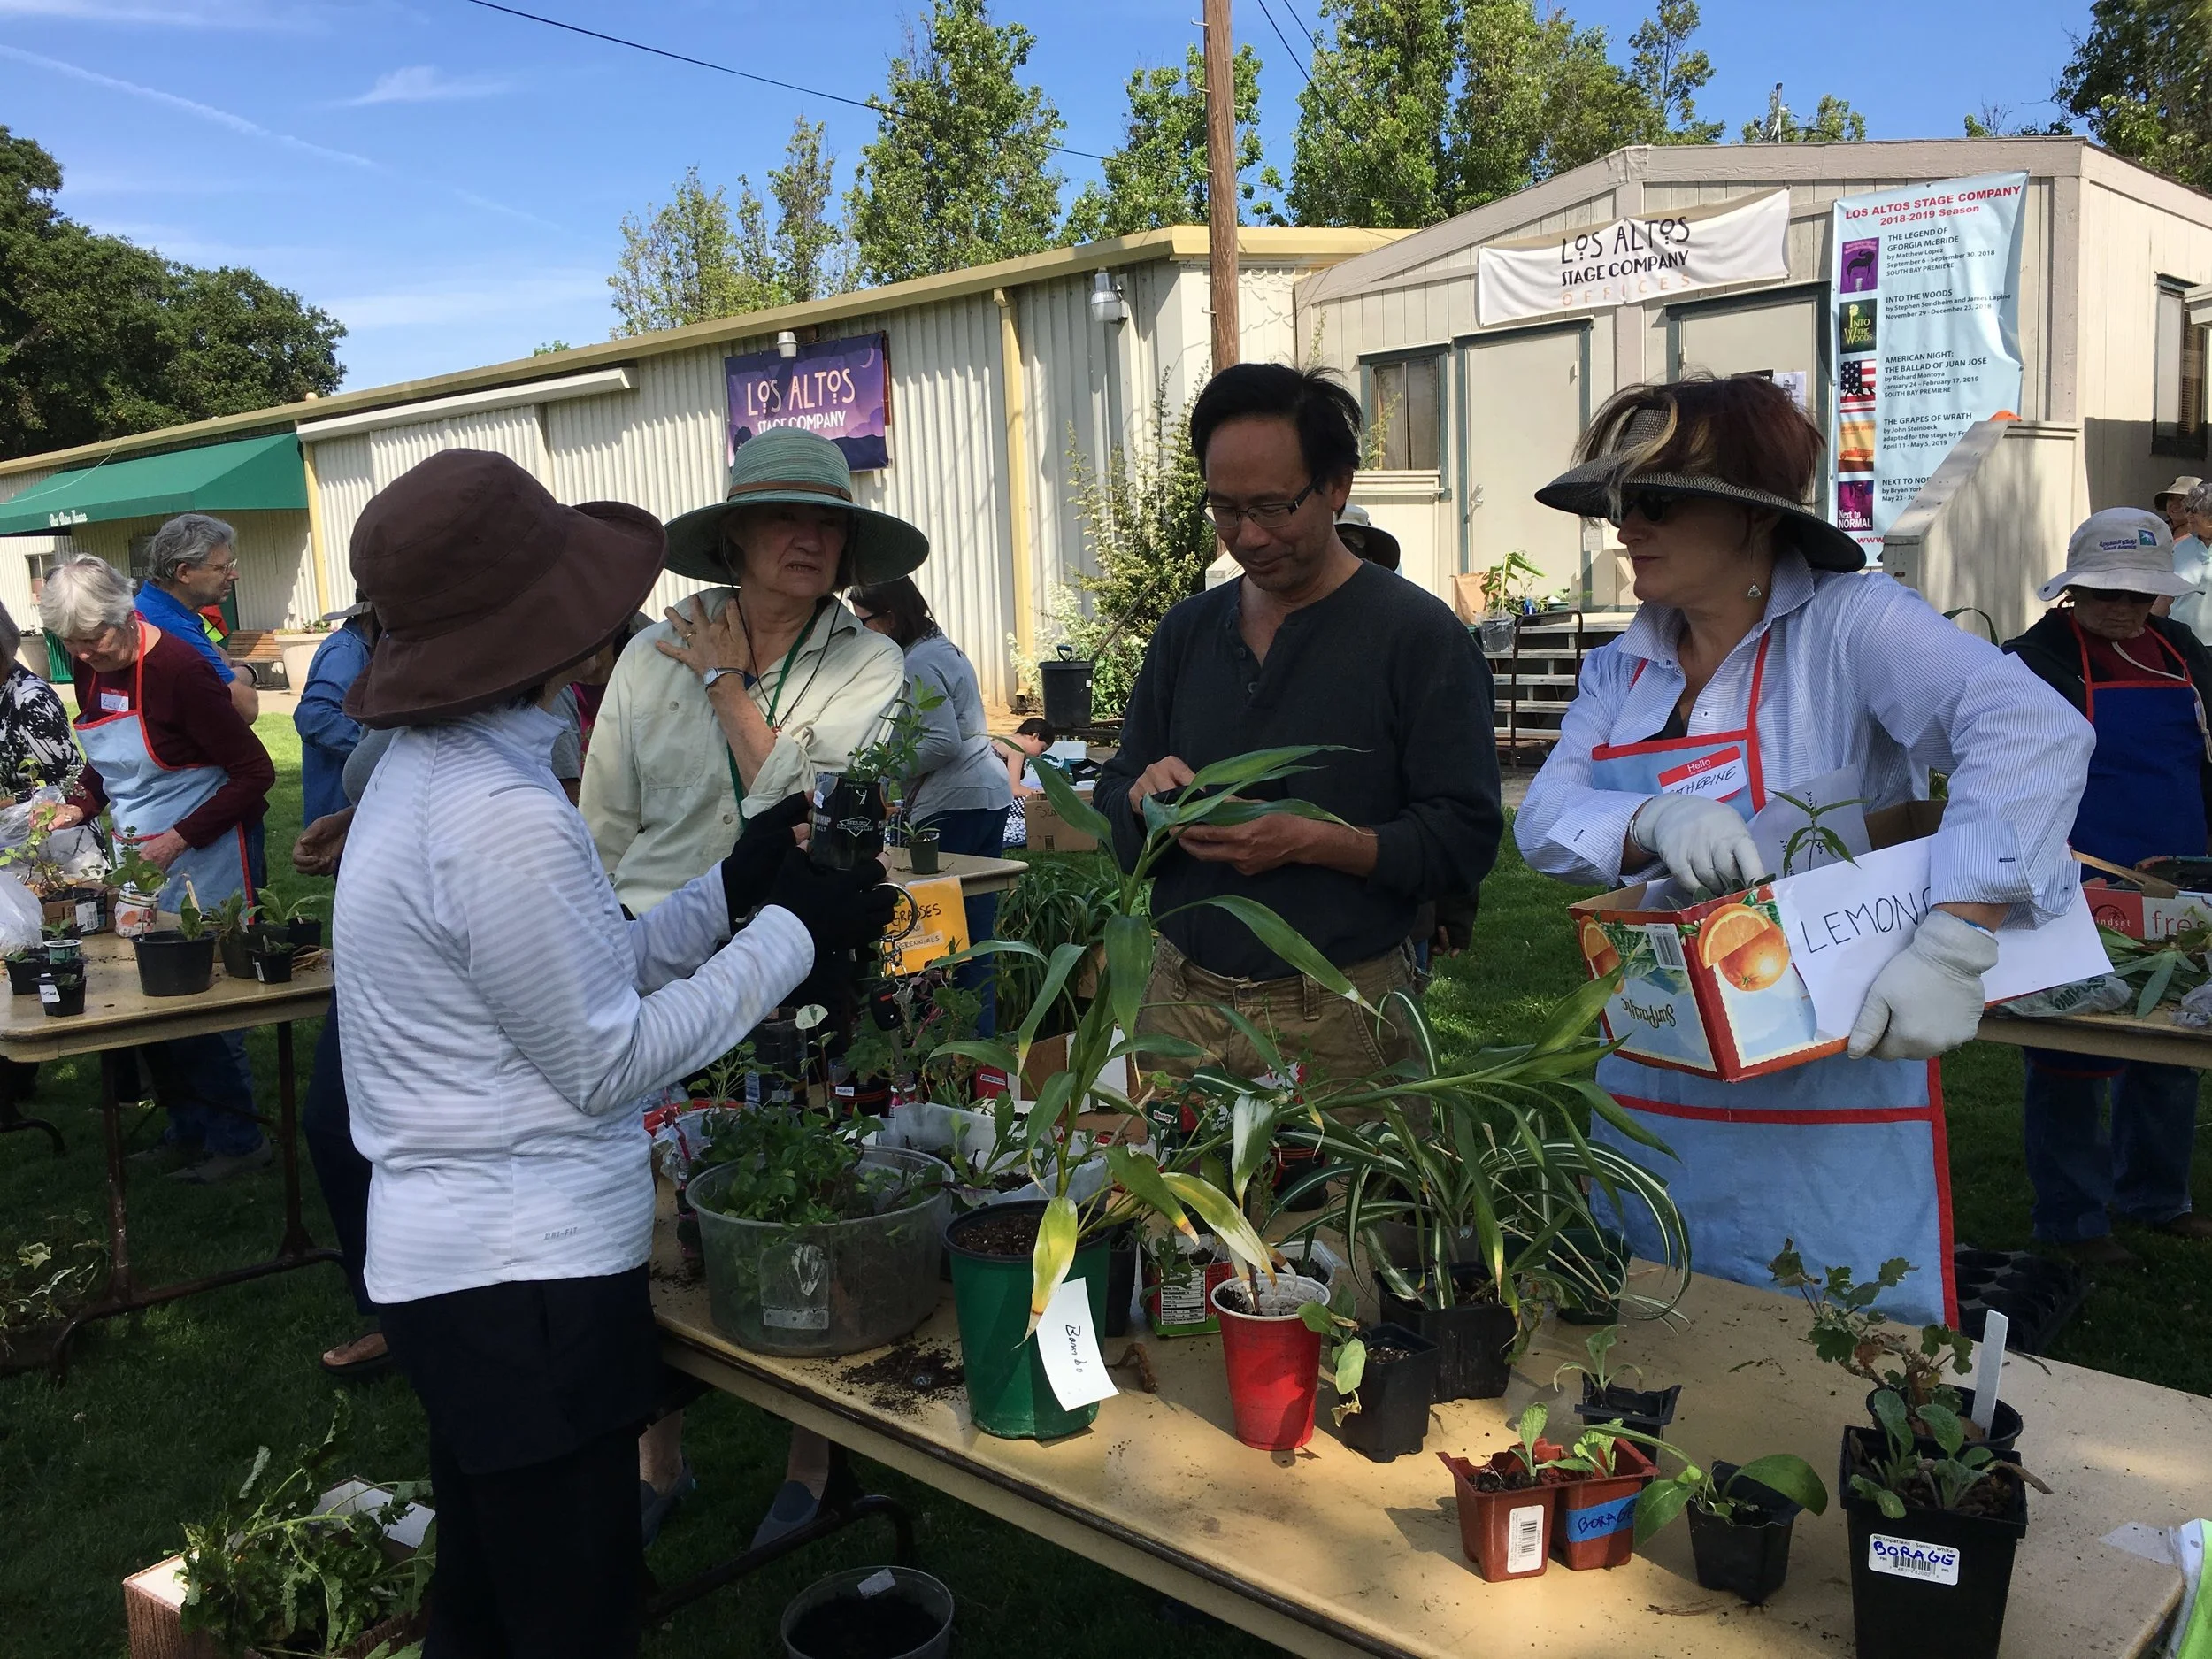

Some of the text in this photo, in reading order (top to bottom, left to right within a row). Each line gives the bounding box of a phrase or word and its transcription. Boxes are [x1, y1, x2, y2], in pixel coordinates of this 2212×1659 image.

[1845, 185, 2021, 219] LOS ALTOS STAGE COMPANY
[1879, 205, 1979, 226] 2018-2019 Season
[1561, 215, 1691, 265] LOS ALTOS
[1887, 227, 1948, 242] THE LEGEND OF
[1887, 242, 1923, 252] GEORGIA
[1924, 235, 1960, 247] McBRIDE
[1896, 250, 1924, 259] Matthew
[1924, 247, 1944, 256] Lopez
[1561, 250, 1690, 286] STAGE COMPANY
[1886, 259, 1921, 271] September
[1931, 252, 1965, 264] September
[1886, 268, 1909, 277] SOUTH
[1923, 262, 1955, 273] PREMIERE
[1562, 273, 1691, 306] OFFICES
[1886, 295, 1905, 303] INTO
[1922, 288, 1953, 300] WOODS
[1894, 303, 1921, 311] Stephen
[1988, 294, 2011, 303] Lapine
[1931, 306, 1962, 315] December
[1885, 350, 1954, 364] AMERICAN NIGHT:
[1900, 362, 1931, 373] BALLAD
[1945, 359, 1966, 368] JUAN
[1968, 357, 1987, 366] JOSE
[1893, 373, 1916, 381] Richard
[1922, 378, 1952, 387] February
[747, 367, 856, 417] LOS ALTOS
[1919, 386, 1952, 395] PREMIERE
[788, 410, 847, 432] COMPANY
[1899, 415, 1929, 425] GRAPES
[1943, 412, 1972, 421] WRATH
[1931, 432, 1948, 441] stage
[1839, 518, 1872, 528] NORMAL
[1686, 758, 1711, 772] Hello
[1670, 765, 1736, 795] THERINE
[1873, 1540, 1955, 1566] BORAGE
